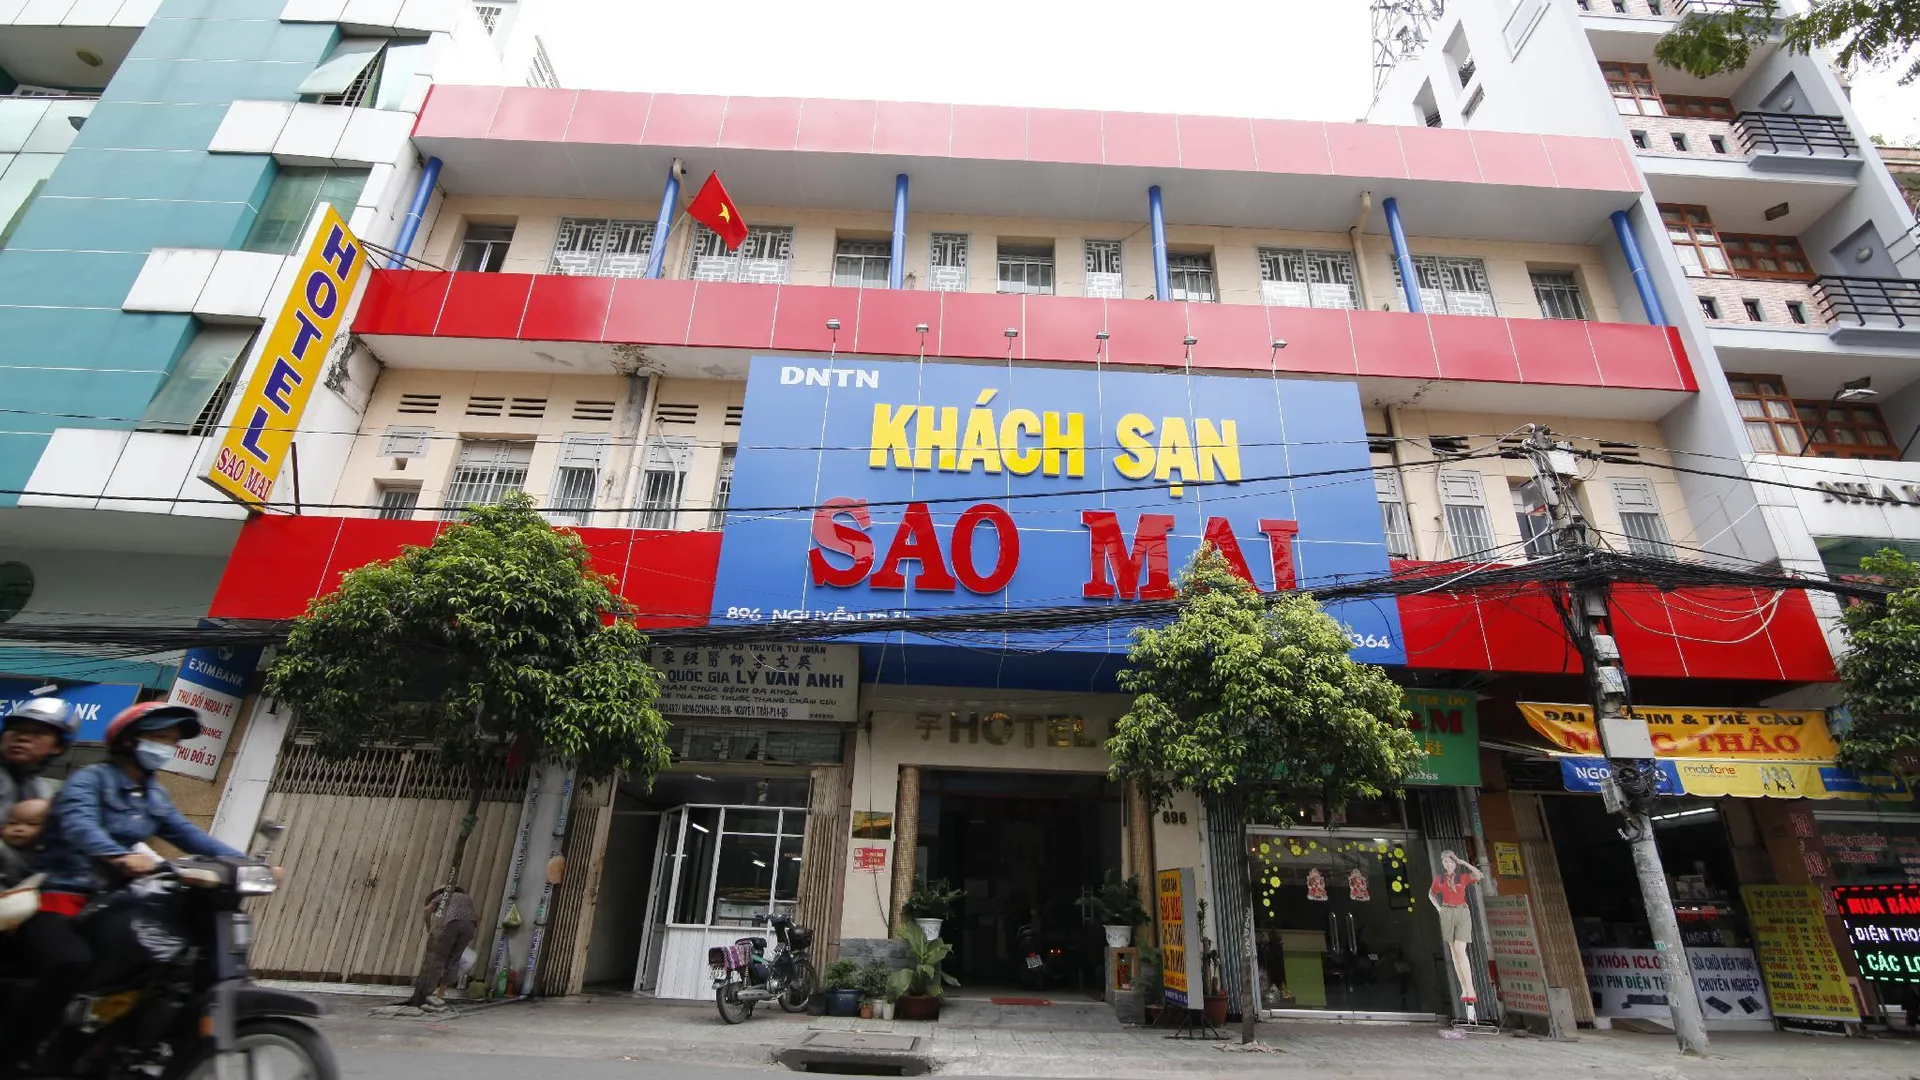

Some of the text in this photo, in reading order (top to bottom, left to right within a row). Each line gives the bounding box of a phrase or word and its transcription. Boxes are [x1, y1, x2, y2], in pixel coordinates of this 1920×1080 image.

[240, 223, 358, 463] HOTEL
[780, 367, 879, 388] DNTN
[868, 388, 1242, 498] KHÁCH SẠN
[215, 446, 273, 502] SAO MAI
[808, 496, 1299, 600] SAO MAI
[726, 606, 762, 622] 896
[188, 658, 244, 687] EXIMBANK
[667, 667, 703, 683] QUỐC
[708, 672, 730, 684] GIA
[806, 673, 844, 688] ANH
[176, 689, 191, 705] THU
[1681, 713, 1699, 725] &
[1703, 710, 1750, 725] THẺ
[1757, 712, 1804, 725] CÀO
[950, 710, 1097, 749] HOTEL
[1686, 726, 1801, 753] THẢO
[174, 745, 190, 761] THU
[205, 753, 217, 767] 33
[1683, 764, 1737, 775] mobifone
[1163, 811, 1187, 824] 896
[1846, 897, 1886, 915] MUA
[1854, 924, 1890, 943] ĐIỆN
[1597, 951, 1630, 969] KHÓA
[1634, 954, 1662, 969] ICLO
[1866, 950, 1901, 972] CÁC
[1606, 975, 1623, 989] PIN
[1625, 972, 1652, 992] ĐIỆN
[1652, 976, 1666, 991] TH
[1699, 974, 1760, 995] CHUYÊN NGHIỆP
